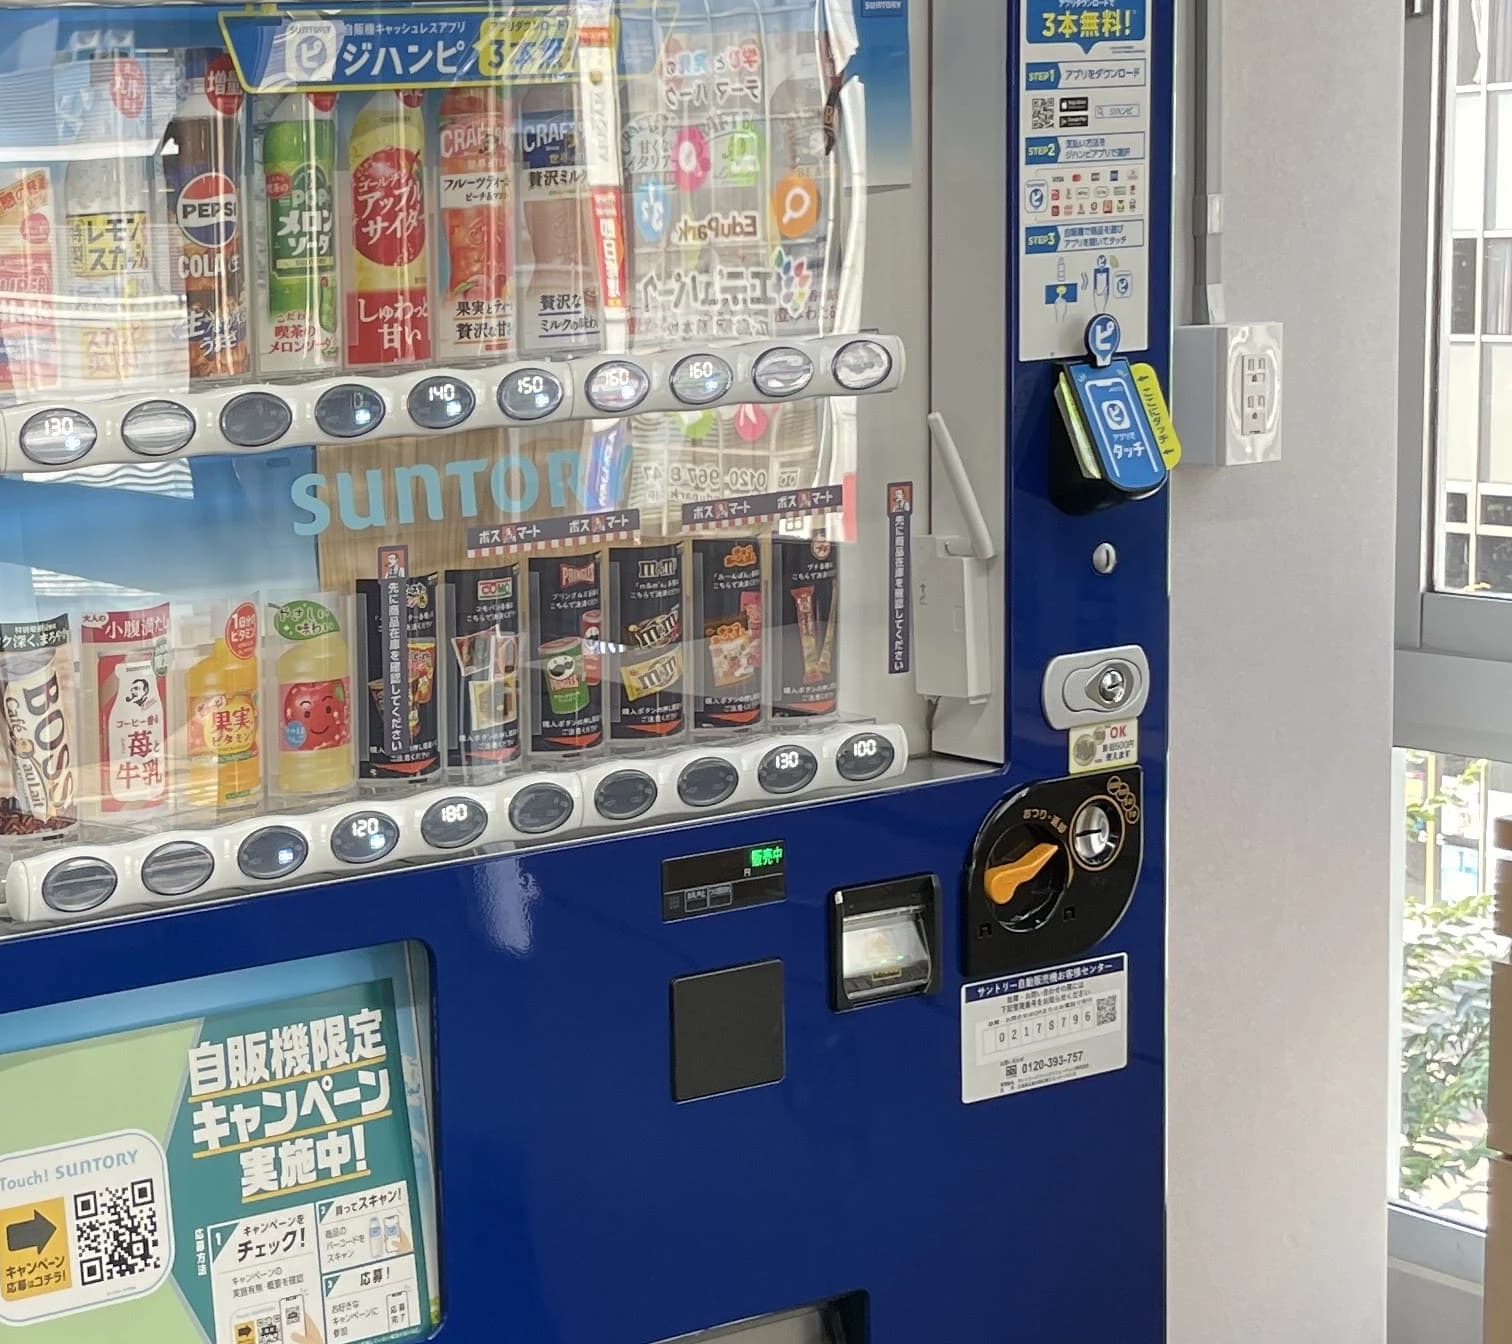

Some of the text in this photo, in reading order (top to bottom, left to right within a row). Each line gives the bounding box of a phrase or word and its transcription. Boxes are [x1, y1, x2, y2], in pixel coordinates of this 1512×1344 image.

[1042, 9, 1131, 38] 3本無料!
[342, 41, 466, 76] ジハンピ
[1065, 68, 1140, 80] アプリをダウンロード
[182, 202, 237, 219] PEPSI
[357, 182, 422, 219] アップル
[277, 210, 332, 237] メロン
[178, 254, 225, 279] COLA
[378, 324, 422, 350] 甘い
[1095, 321, 1114, 350] ピ
[688, 363, 713, 378] 160
[427, 384, 456, 401] 140
[515, 377, 544, 395] 150
[43, 417, 75, 436] 130
[1113, 441, 1145, 459] タッチ
[693, 500, 751, 519] ボス マート
[777, 492, 833, 508] ボス マート
[569, 515, 629, 533] ボス マート
[479, 526, 541, 544] ボス マート
[214, 707, 251, 732] 果実
[23, 670, 73, 809] BOSS
[1110, 725, 1127, 738] OK
[853, 739, 878, 758] 100
[774, 752, 800, 770] 130
[116, 760, 163, 790] 牛乳
[441, 806, 468, 823] 180
[351, 818, 379, 837] 120
[751, 846, 783, 867] 販売中
[187, 1008, 387, 1097] 自販機限定
[1021, 1051, 1084, 1074] 0120-393-757
[192, 1068, 392, 1151] キャンペーン
[55, 1148, 139, 1181] SUNTORY
[240, 1125, 368, 1194] 実施中!
[244, 1214, 305, 1236] キャンペーンを
[238, 1228, 306, 1262] チェック!
[4, 1255, 67, 1280] キャンペーン
[360, 1267, 390, 1286] 応募!
